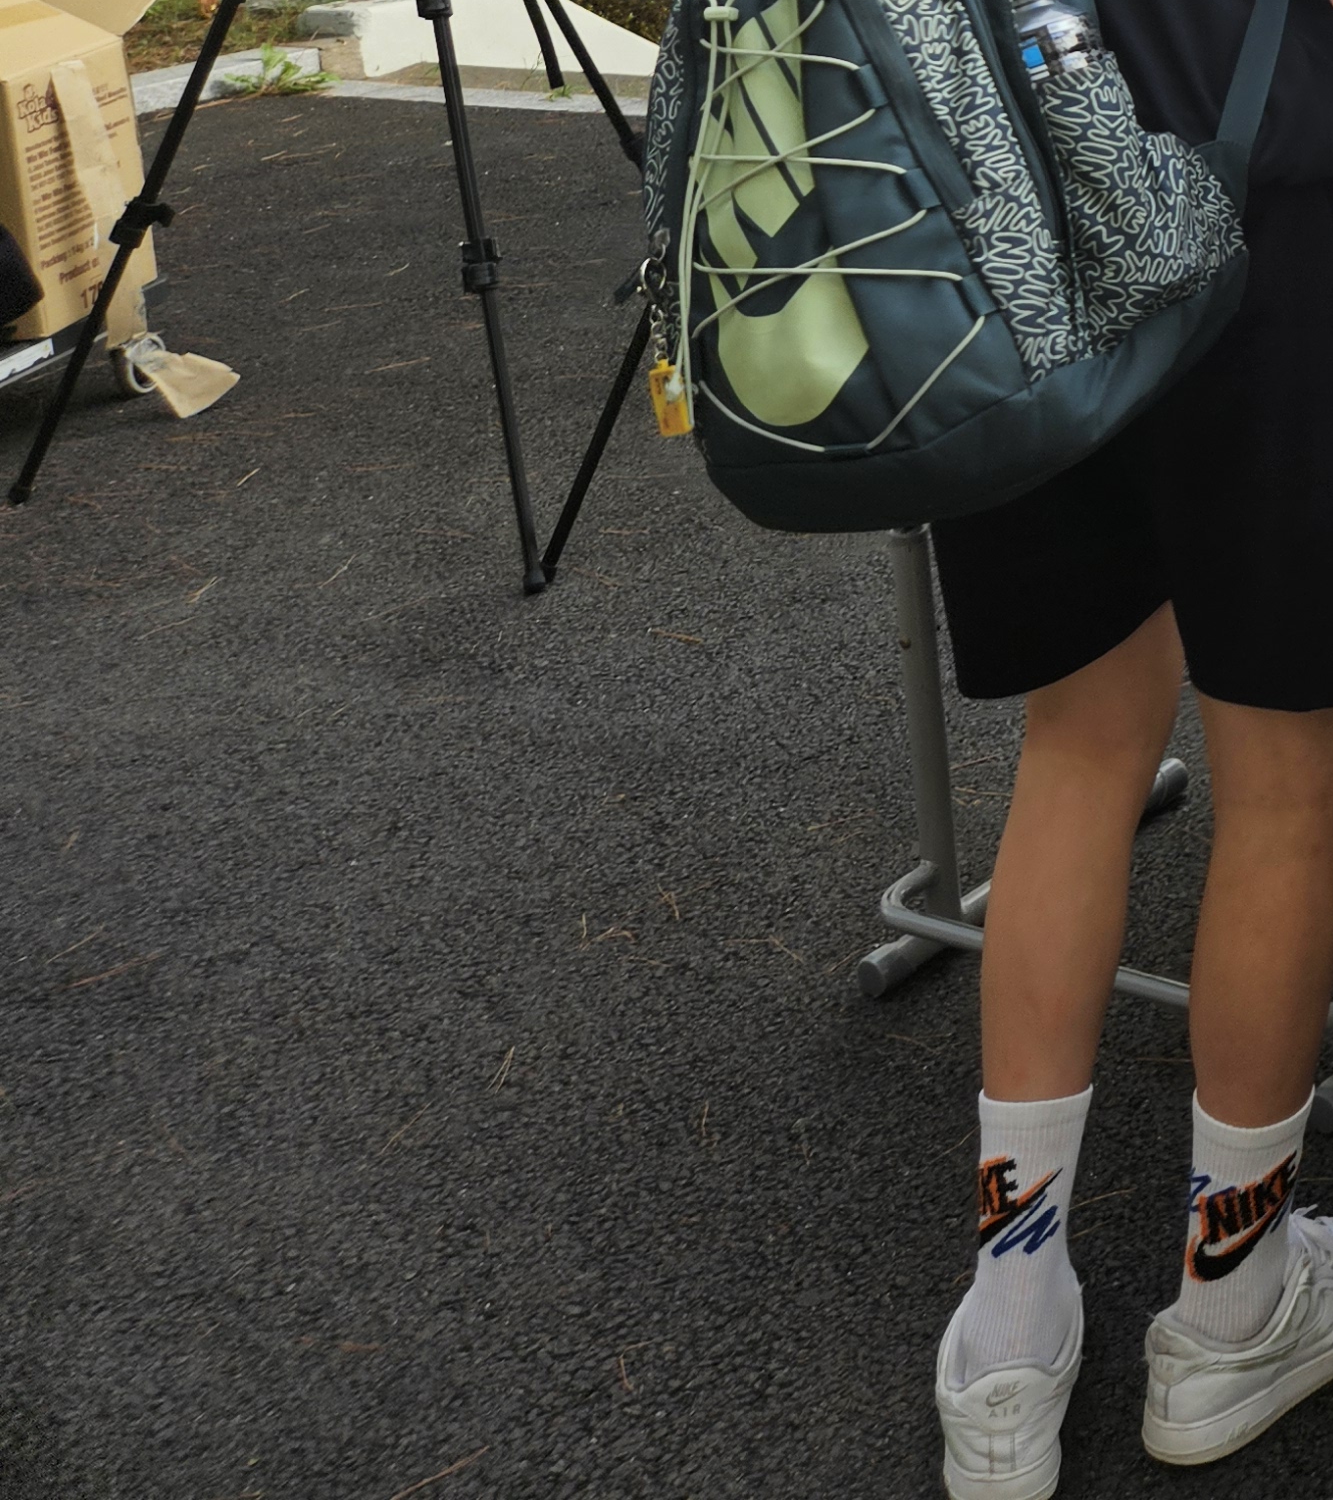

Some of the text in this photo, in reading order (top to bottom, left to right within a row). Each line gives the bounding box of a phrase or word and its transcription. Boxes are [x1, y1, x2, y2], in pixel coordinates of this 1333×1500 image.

[17, 96, 47, 119] Kola
[27, 107, 59, 133] Kids
[980, 1157, 1020, 1215] KE
[1200, 1152, 1296, 1244] NIKE
[991, 1381, 1020, 1397] NIKE
[988, 1403, 1021, 1419] AIR
